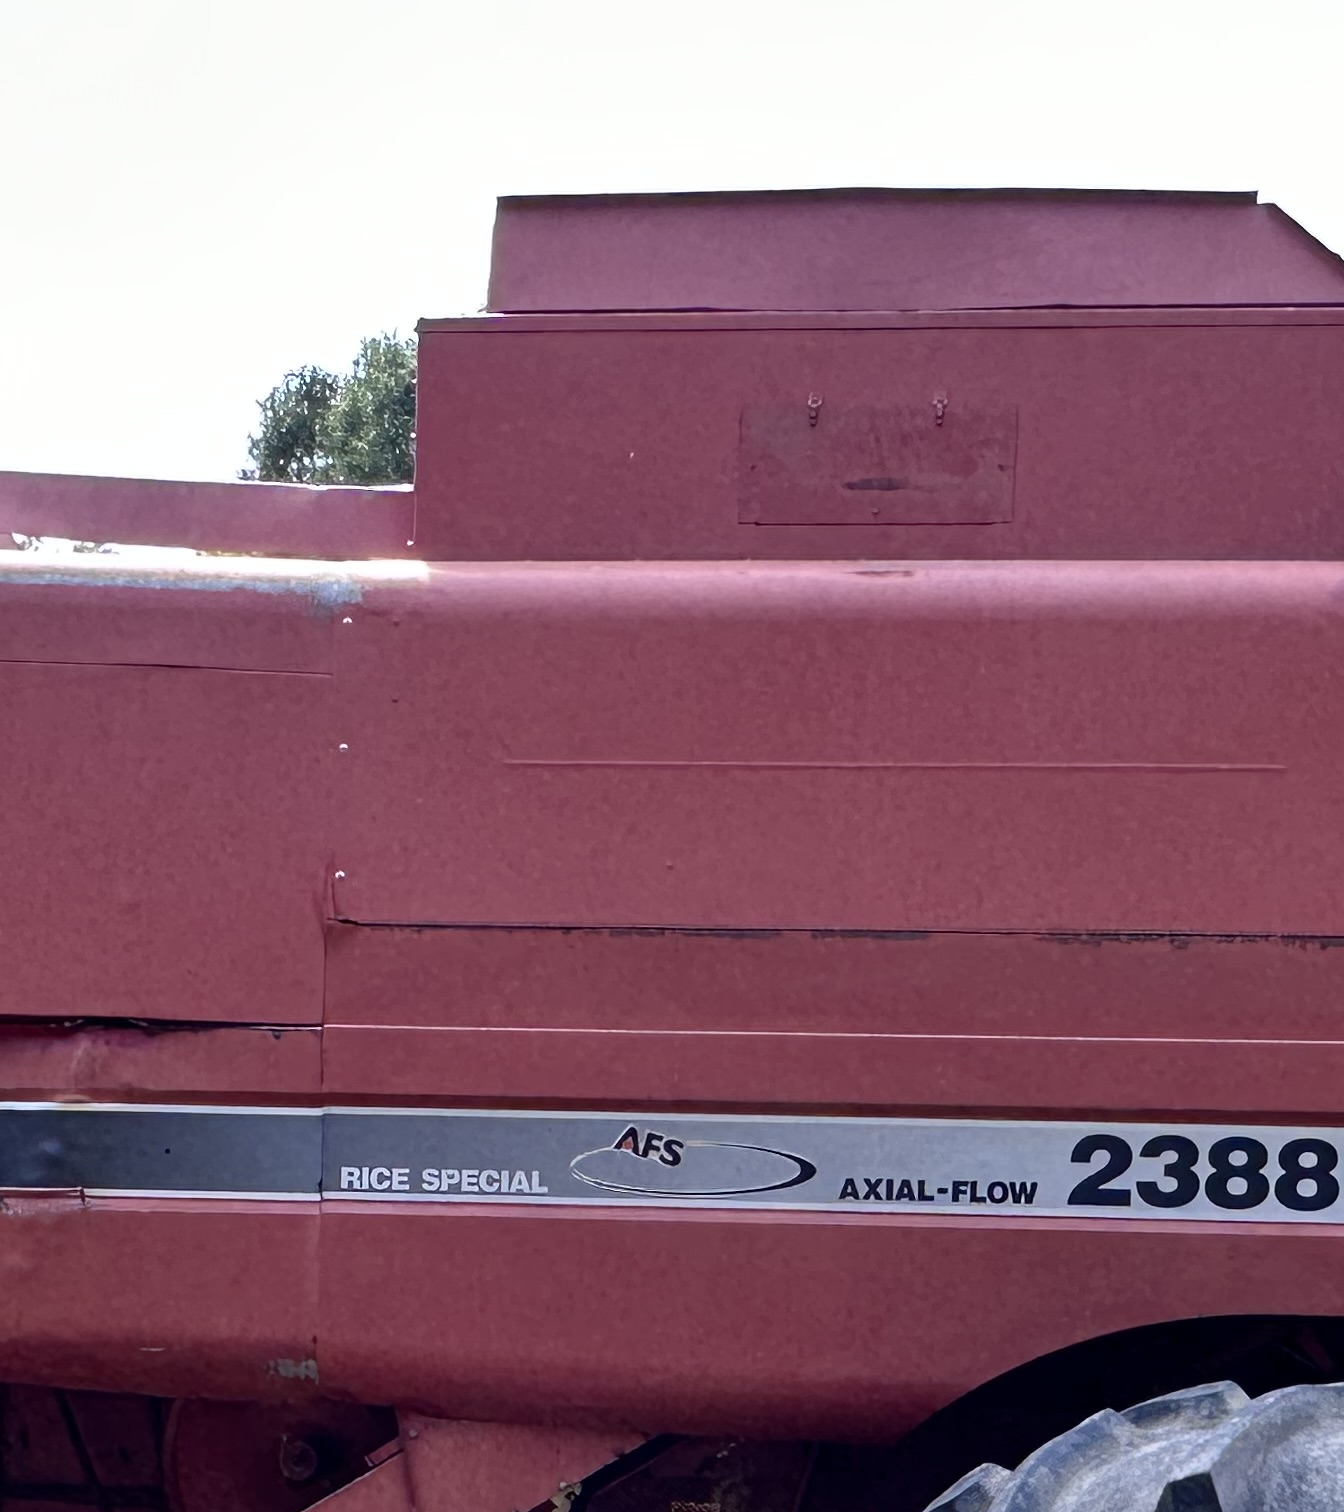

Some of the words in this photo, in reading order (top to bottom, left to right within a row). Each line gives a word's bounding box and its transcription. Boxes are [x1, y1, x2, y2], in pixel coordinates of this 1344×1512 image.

[613, 1125, 685, 1168] AFS
[340, 1166, 410, 1191] RICE
[421, 1168, 548, 1194] SPECIAL
[1067, 1134, 1340, 1211] 2388
[838, 1177, 1038, 1205] AXIAL-FLOW
